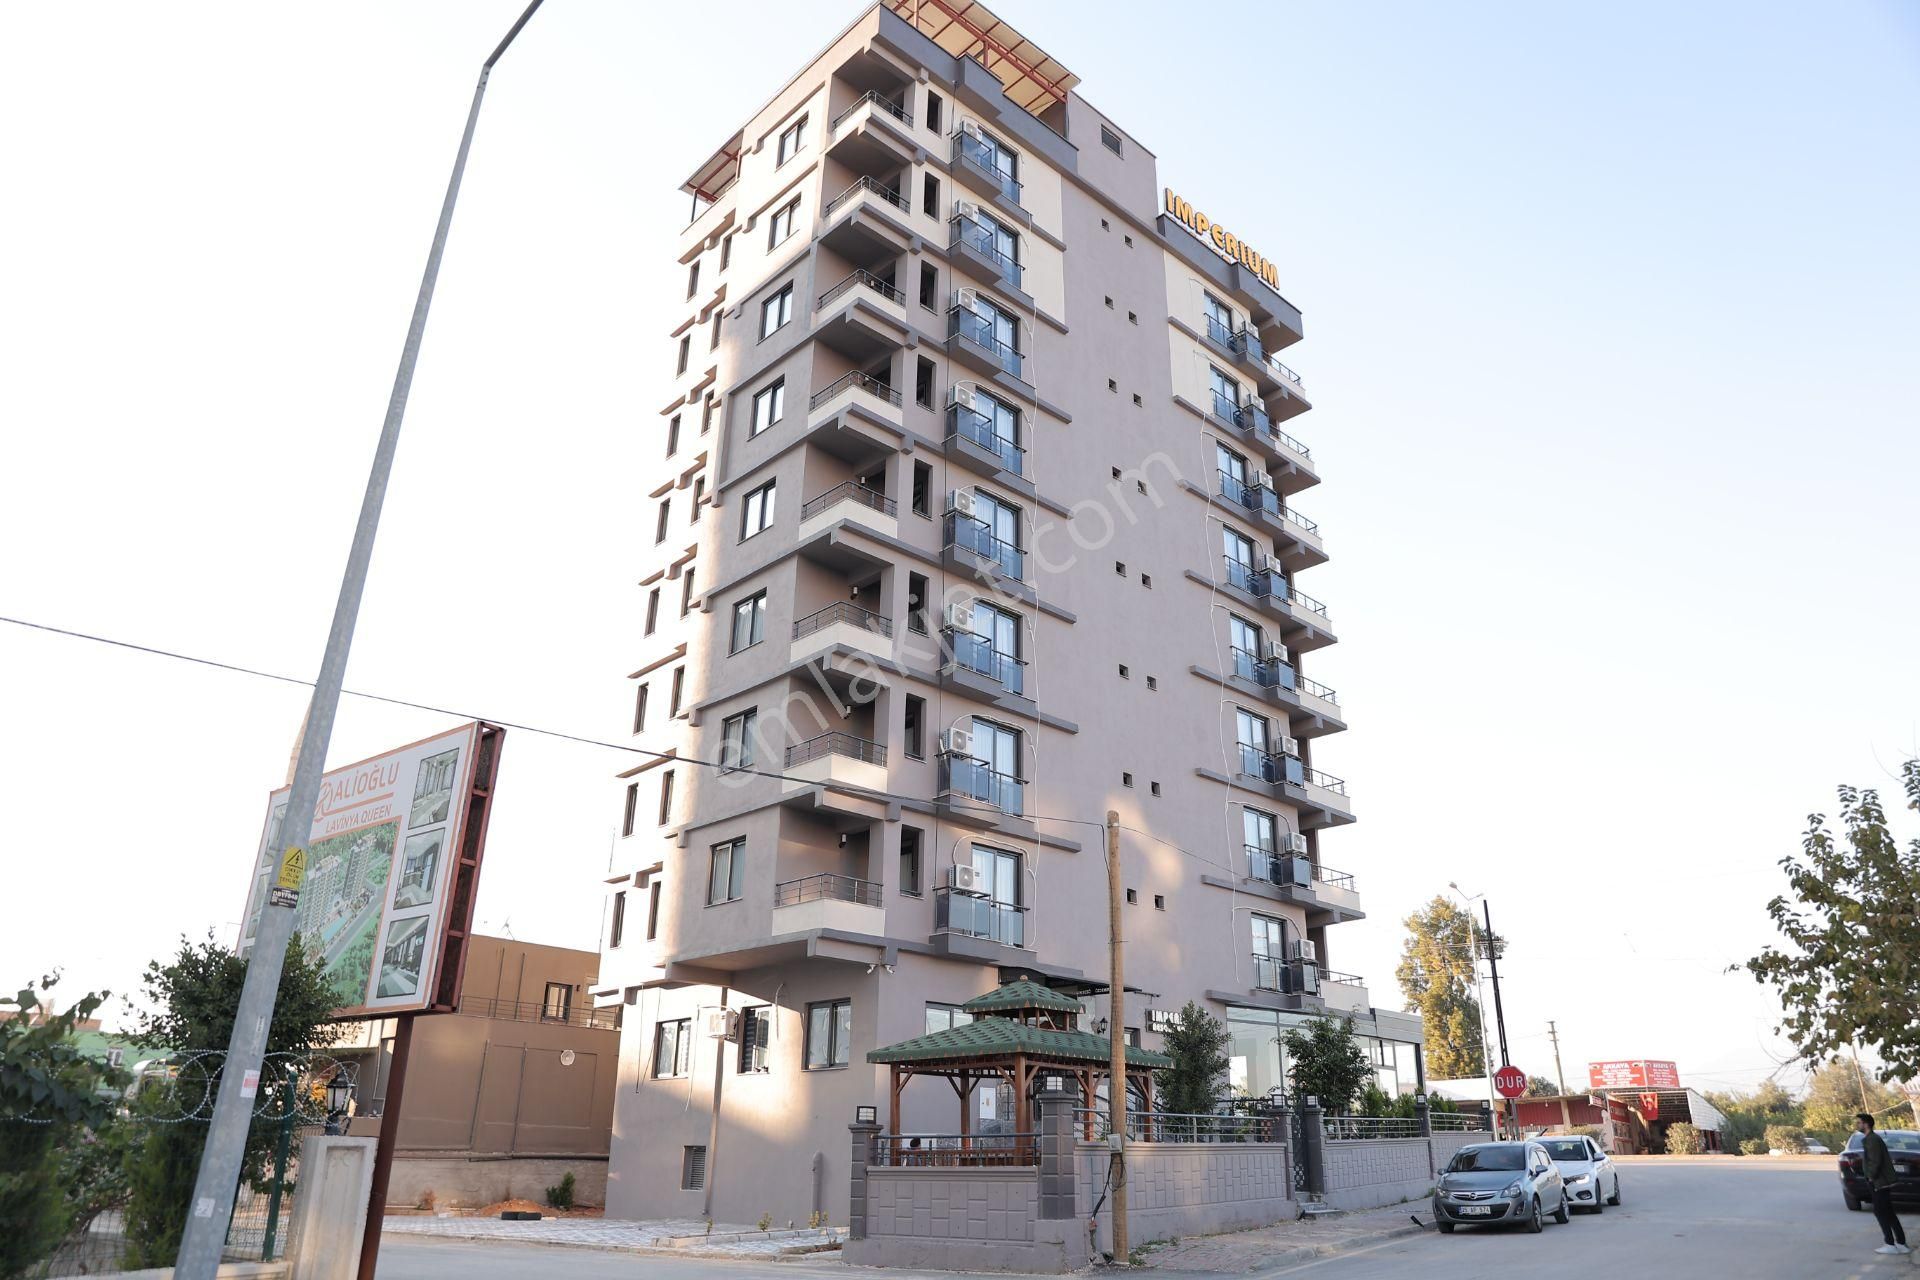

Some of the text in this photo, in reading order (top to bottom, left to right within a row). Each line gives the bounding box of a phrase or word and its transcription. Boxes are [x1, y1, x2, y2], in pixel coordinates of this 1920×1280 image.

[1165, 187, 1279, 291] IMPERIUM
[361, 804, 392, 824] QUEEN
[1497, 1075, 1524, 1089] DUR
